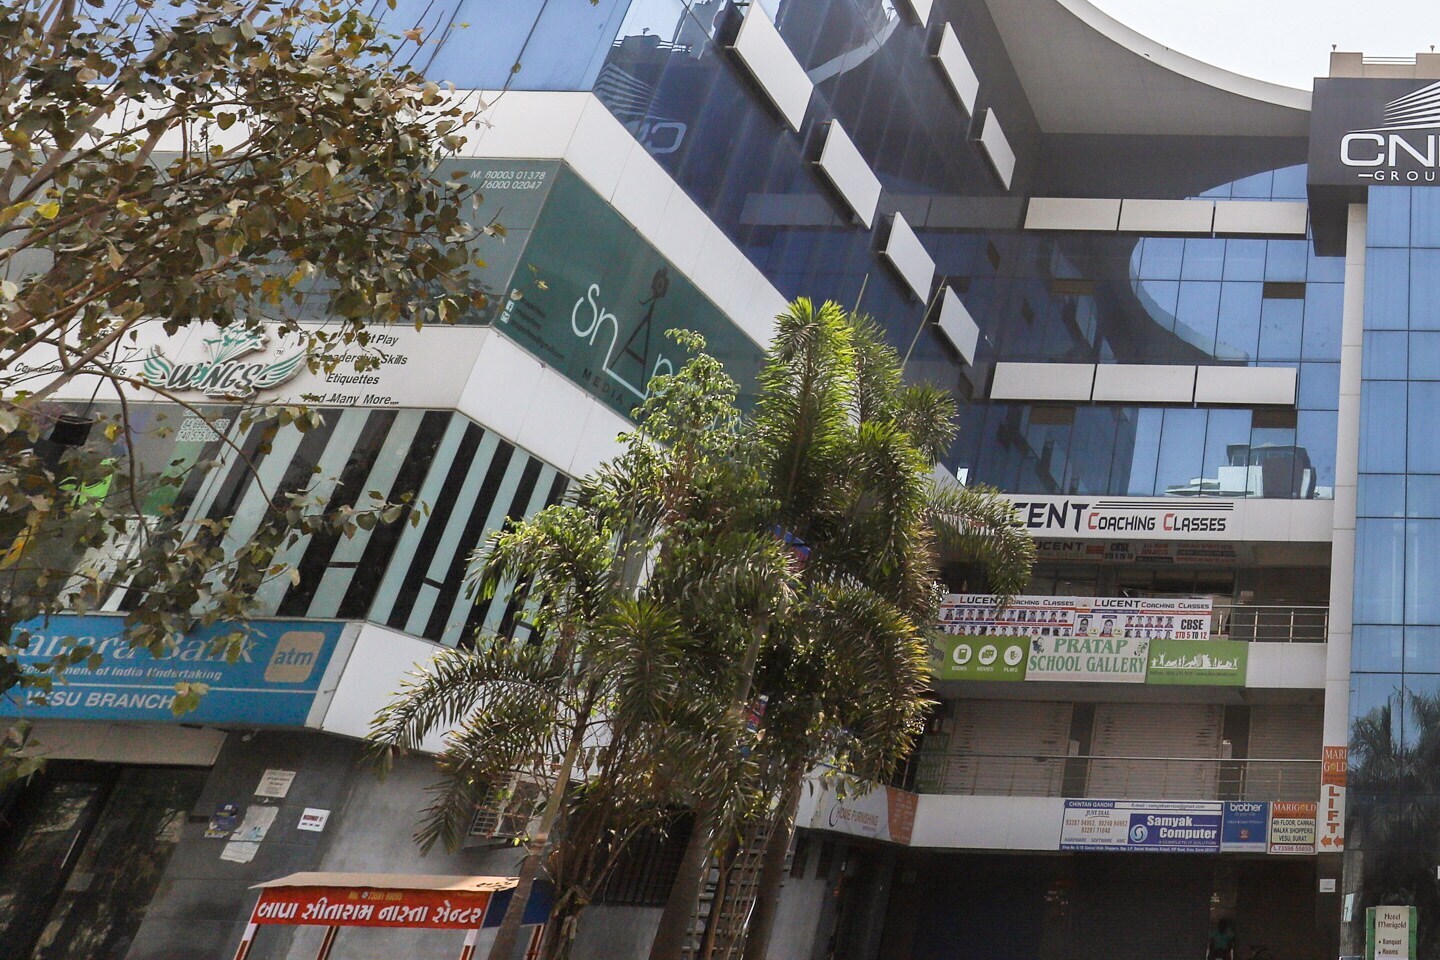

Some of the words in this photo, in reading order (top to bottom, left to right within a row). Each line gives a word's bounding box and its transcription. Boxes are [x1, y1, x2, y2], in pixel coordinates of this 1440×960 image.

[515, 171, 546, 180] 01378
[480, 180, 510, 189] 76000
[511, 181, 542, 190] 02047
[376, 334, 399, 346] Play
[381, 354, 407, 365] Skills
[326, 373, 380, 385] Etiquettes
[330, 393, 359, 405] Many
[1002, 499, 1090, 533] CENT
[1088, 513, 1156, 531] COACHING
[1163, 513, 1226, 532] CLASSES
[1094, 599, 1141, 608] LUCENT
[1178, 602, 1210, 610] CLASSES
[1181, 619, 1204, 631] CBSE
[1175, 631, 1186, 640] STD
[1192, 632, 1199, 640] TO
[1200, 632, 1207, 640] 12
[1054, 638, 1129, 654] PRATAP
[274, 651, 312, 666] atm
[1029, 655, 1081, 672] SCHOOL
[1086, 656, 1147, 674] GALLERY
[96, 666, 110, 676] of
[112, 667, 143, 677] India
[1325, 749, 1347, 759] MARI
[1230, 803, 1262, 812] brother
[1327, 786, 1340, 834] LIFT
[1147, 815, 1193, 827] Samyak
[1159, 828, 1217, 840] Computer
[257, 902, 298, 919] બાપા
[301, 896, 372, 921] સીતારામ
[377, 904, 428, 923] નાસ્તા
[432, 899, 482, 924] સેન્ટર
[1384, 913, 1401, 921] Hotel
[1377, 921, 1407, 929] Marigold
